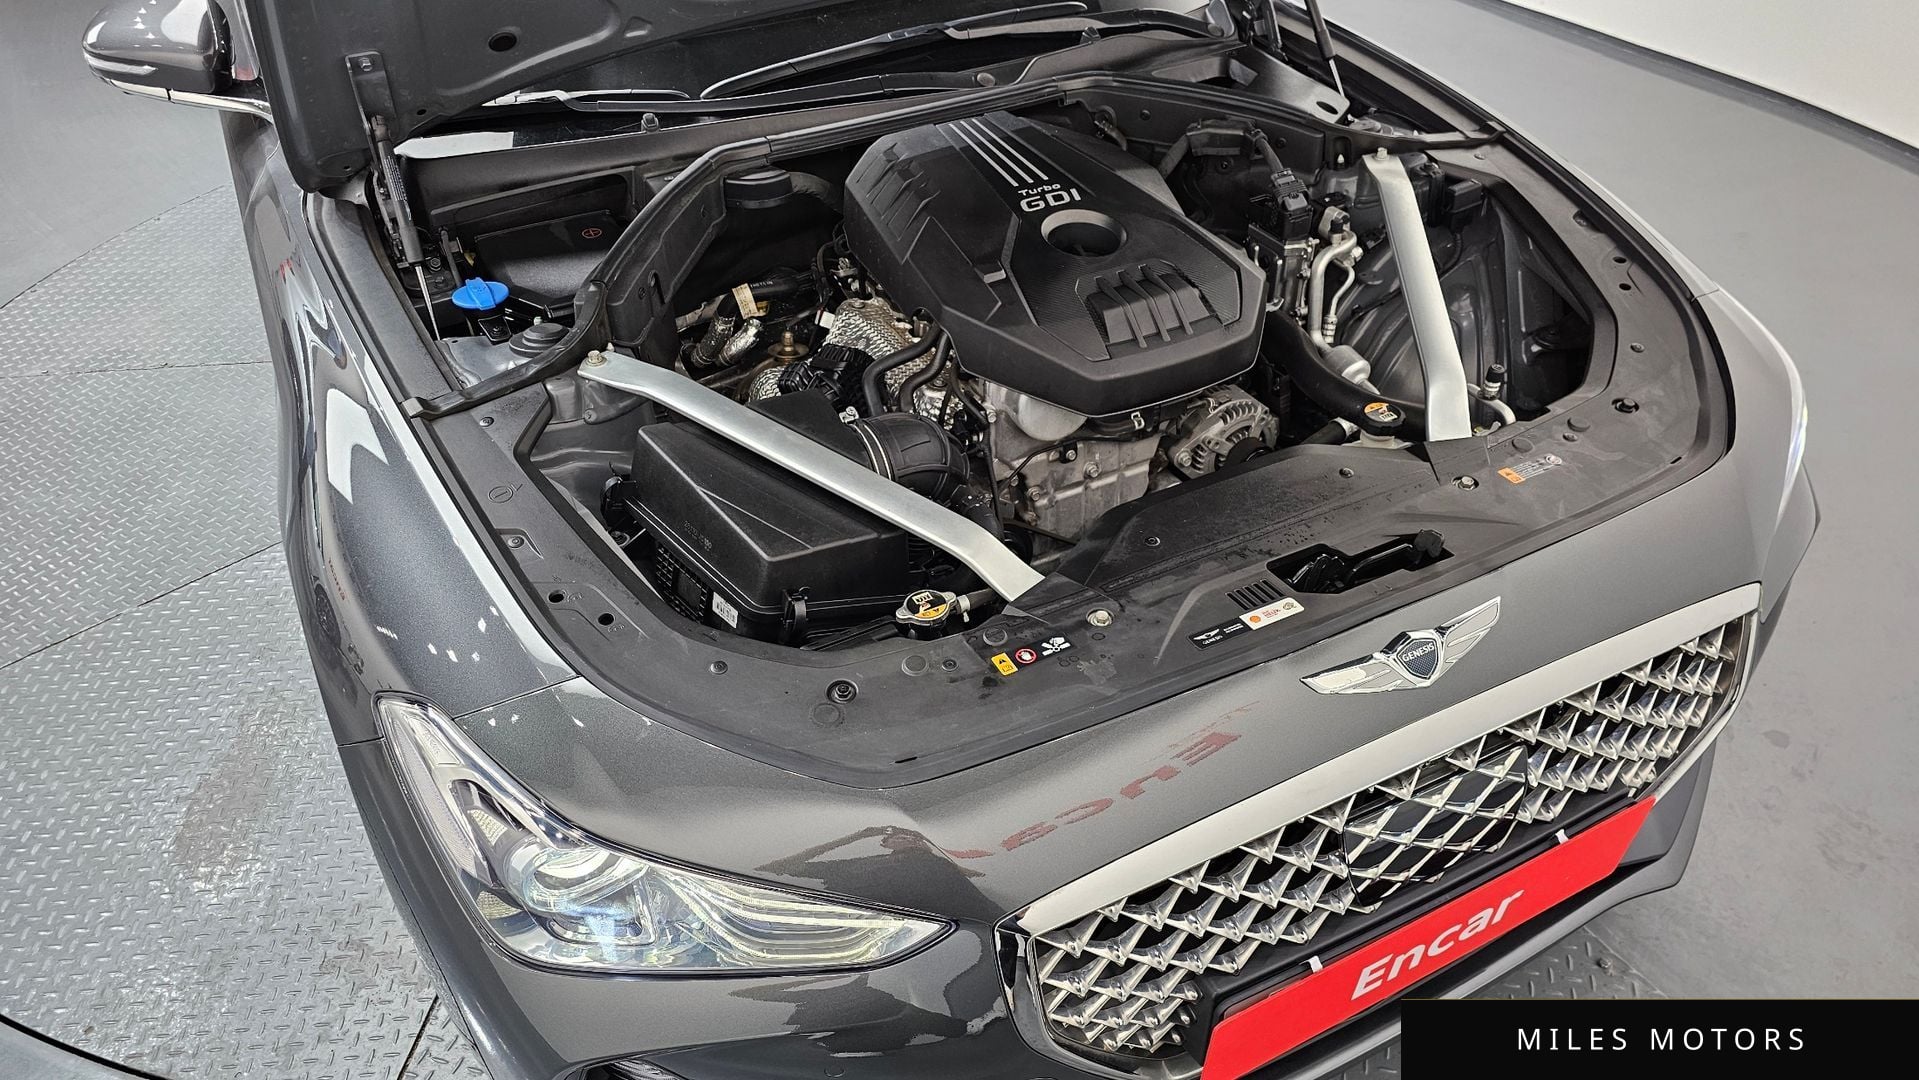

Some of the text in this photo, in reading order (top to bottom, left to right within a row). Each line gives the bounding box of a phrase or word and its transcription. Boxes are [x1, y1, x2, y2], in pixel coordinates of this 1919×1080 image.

[1018, 184, 1061, 196] Turbo
[1020, 188, 1081, 212] GDI
[1402, 642, 1434, 662] GENESIS
[1351, 889, 1525, 1001] Encar
